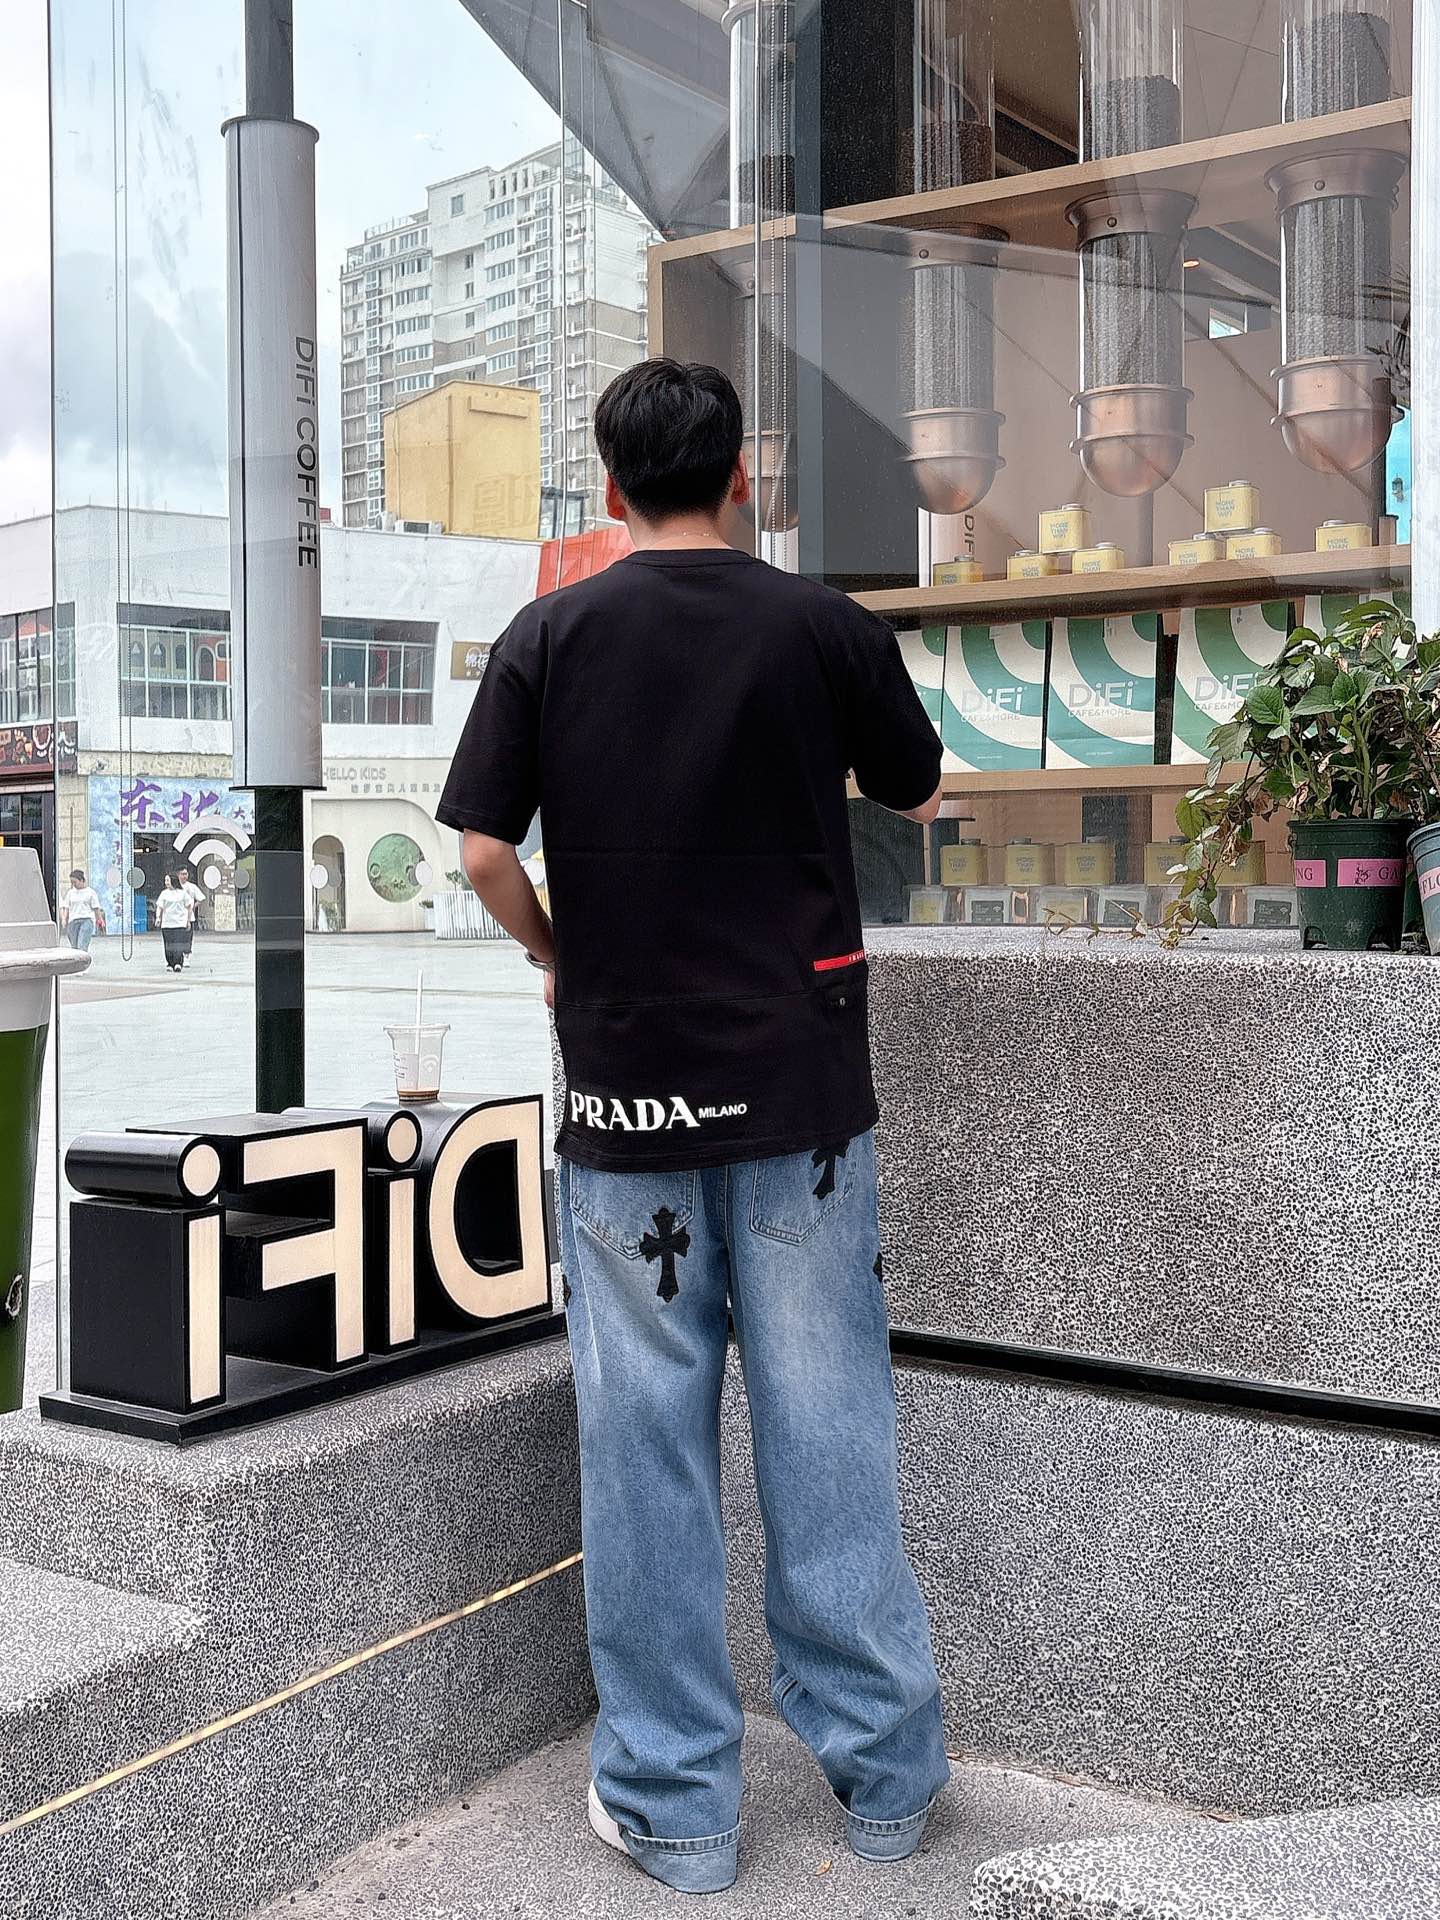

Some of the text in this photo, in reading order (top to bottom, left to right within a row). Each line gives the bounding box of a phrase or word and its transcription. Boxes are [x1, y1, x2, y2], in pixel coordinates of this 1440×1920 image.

[296, 336, 317, 569] DiFi COFFEE
[961, 686, 1024, 713] DiFi
[1069, 681, 1133, 708] DiFi
[360, 767, 387, 780] KIDS
[570, 1089, 748, 1131] PRADA MILANO
